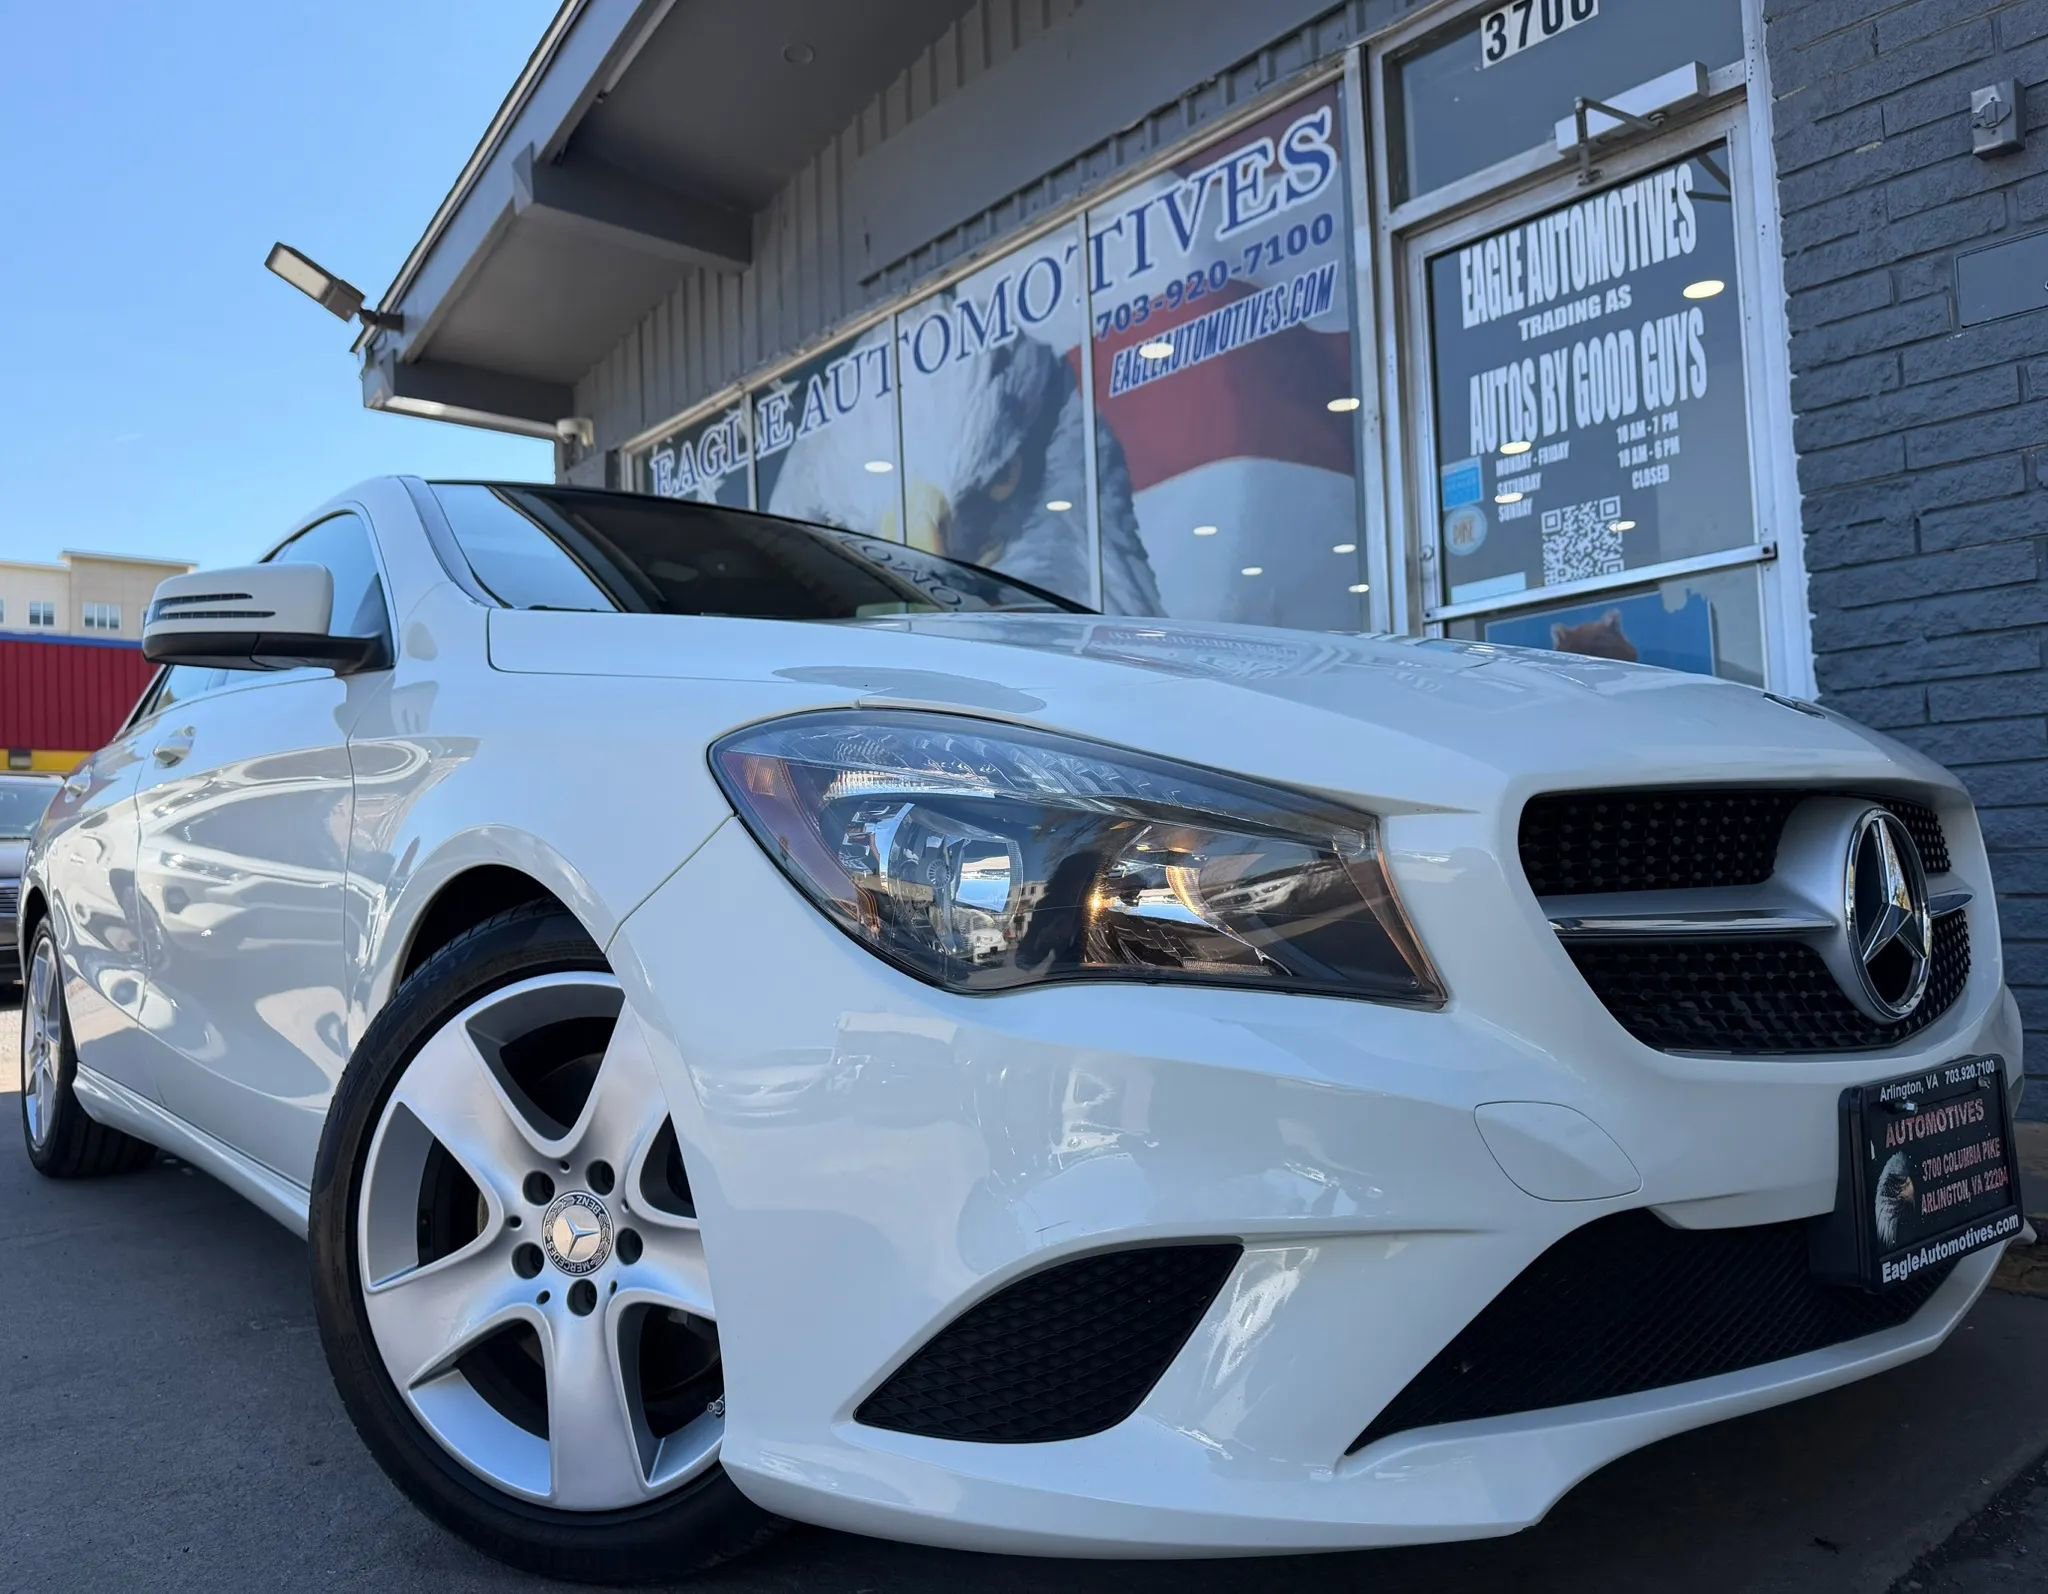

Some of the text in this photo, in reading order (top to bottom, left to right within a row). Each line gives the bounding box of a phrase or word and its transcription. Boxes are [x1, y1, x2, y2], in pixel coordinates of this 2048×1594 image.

[1459, 163, 1697, 329] EAGLE AUTOMOTIVES
[1097, 213, 1334, 340] 703-920-7100
[650, 106, 1337, 498] EAGLE AUTOMOTIVES
[1518, 284, 1632, 341] TRADING AS
[1110, 262, 1337, 395] EAGLEAUTOMOTIVES.COM
[1470, 307, 1707, 456] AUTOS BY GOOD GUYS
[1616, 424, 1629, 444] 10
[1630, 420, 1646, 442] AM
[1652, 416, 1659, 435] 7
[1661, 410, 1680, 433] PM
[1495, 451, 1532, 477] MONDAY
[1538, 440, 1570, 466] FRIDAY
[1618, 449, 1631, 469] 10
[1631, 443, 1648, 466] AM
[1663, 435, 1681, 457] PM
[1497, 472, 1541, 498] SATURDAY
[1631, 463, 1670, 490] CLOSED
[1498, 497, 1533, 523] SUNDAY
[1880, 1059, 1995, 1102] Arlington, VA 703.920.7100
[1886, 1098, 1985, 1148] AUTOMOTIVES
[1922, 1136, 2001, 1182] 3700 COLUMBIA PIKE
[576, 1195, 601, 1214] BENZ
[1921, 1179, 1971, 1215] ARLINGTON,
[1971, 1174, 1984, 1195] VA
[547, 1241, 591, 1273] MERCEDES
[1882, 1213, 2019, 1284] EagleAutomotives.com
